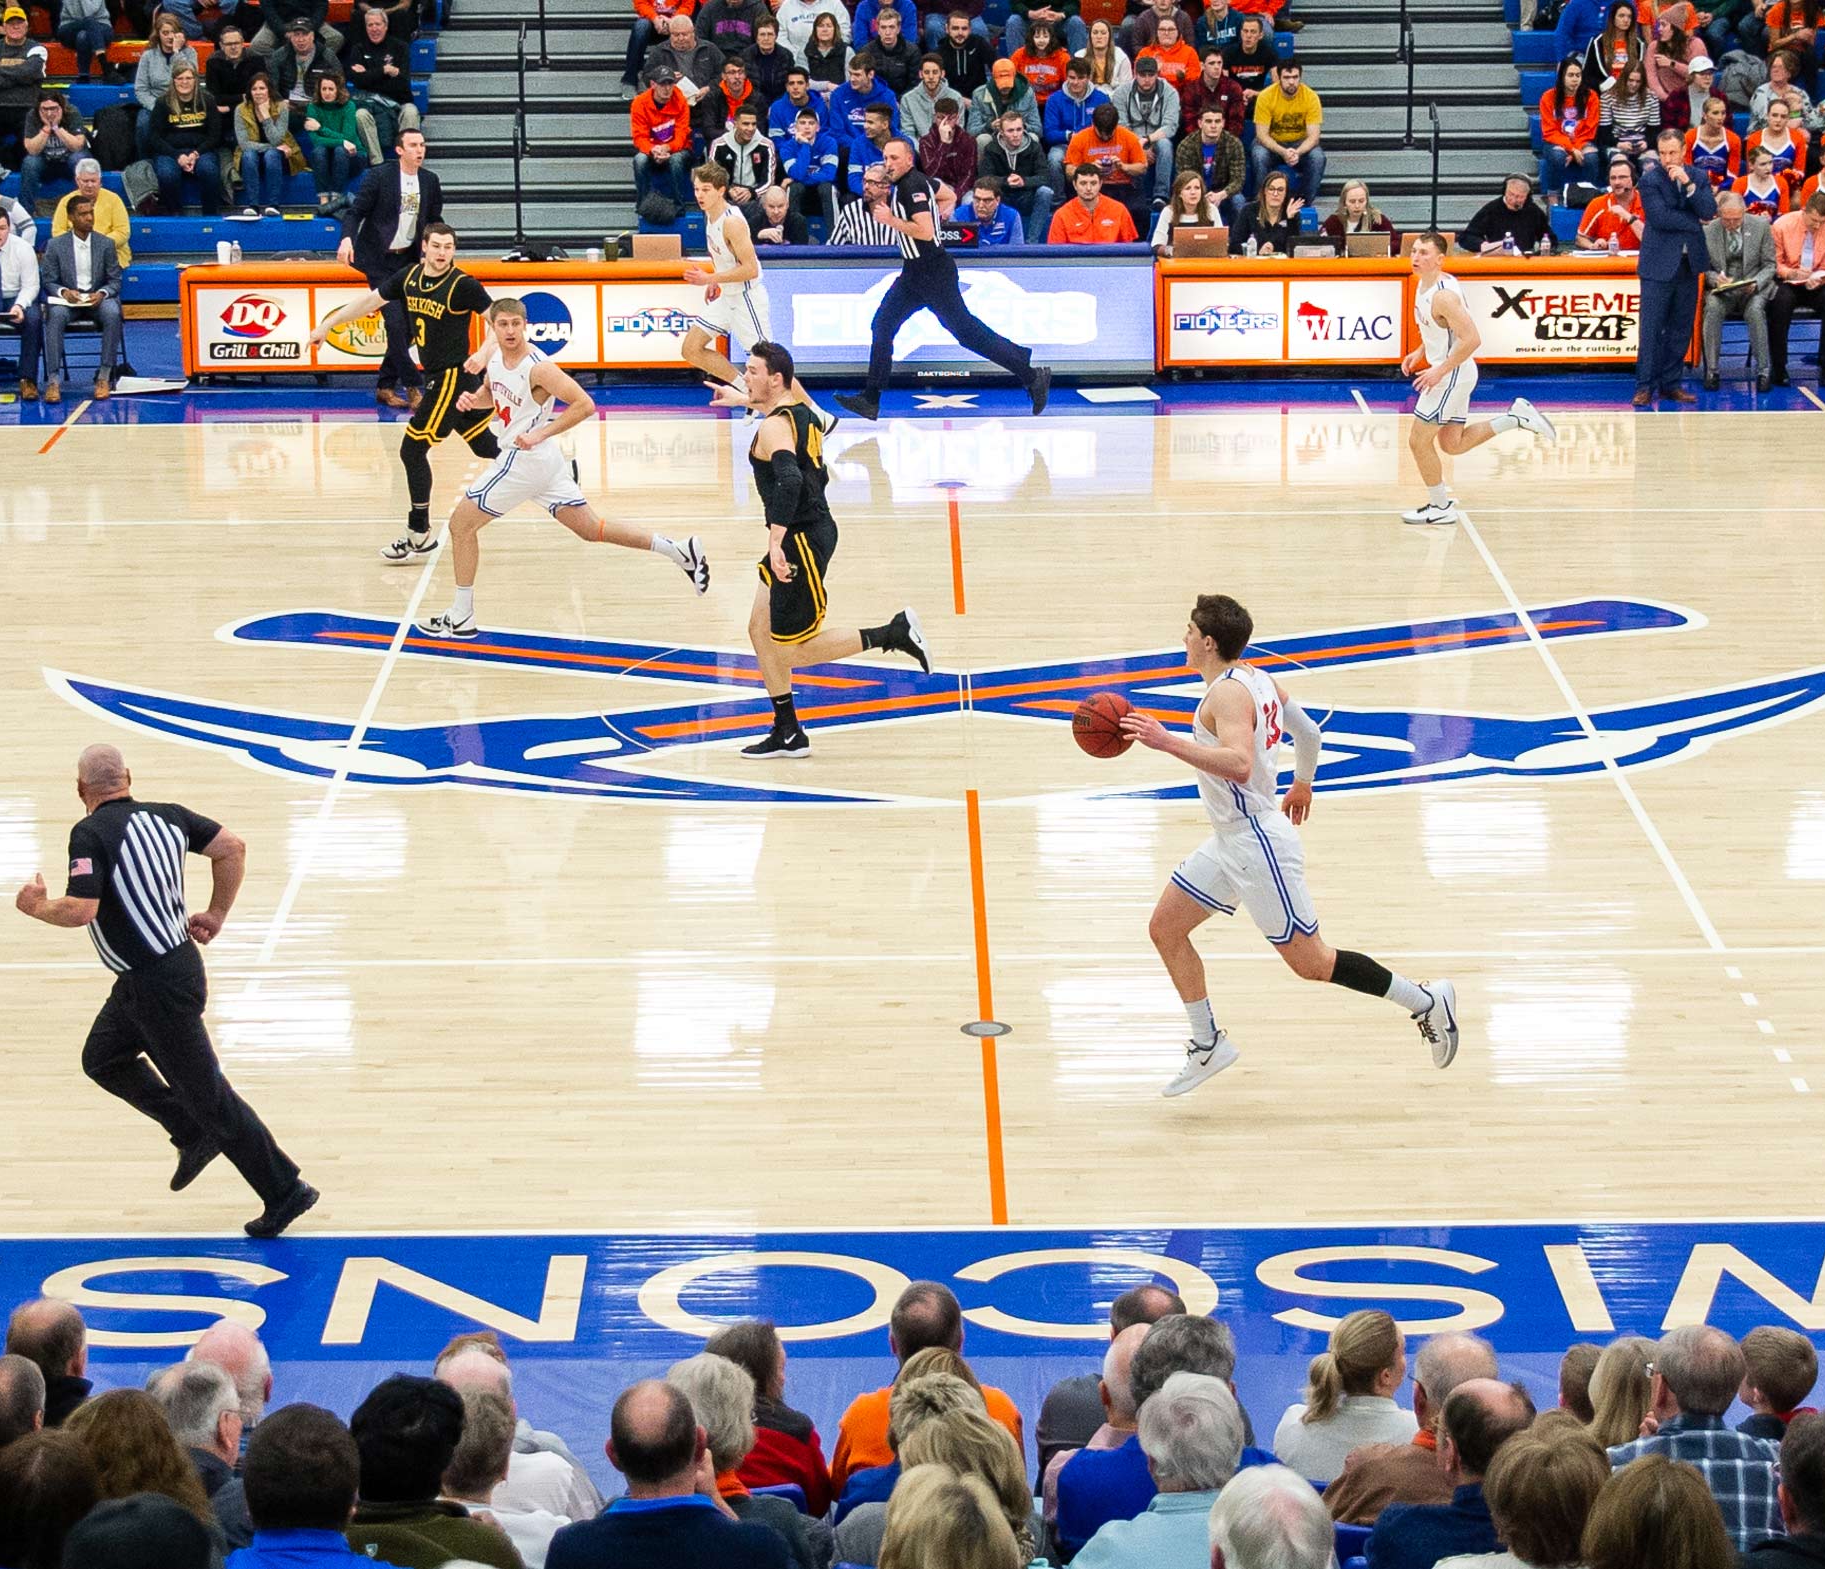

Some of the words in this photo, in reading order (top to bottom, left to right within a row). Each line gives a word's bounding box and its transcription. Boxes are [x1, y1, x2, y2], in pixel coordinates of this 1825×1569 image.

[230, 302, 278, 330] DQ
[608, 316, 696, 332] PIONEER
[1174, 313, 1278, 331] PIONEERS
[415, 318, 426, 347] 3
[1298, 314, 1393, 341] WIAC
[1538, 317, 1618, 339] 107.1
[213, 344, 248, 358] Grill
[1566, 344, 1583, 353] the
[1586, 344, 1621, 355] cutting
